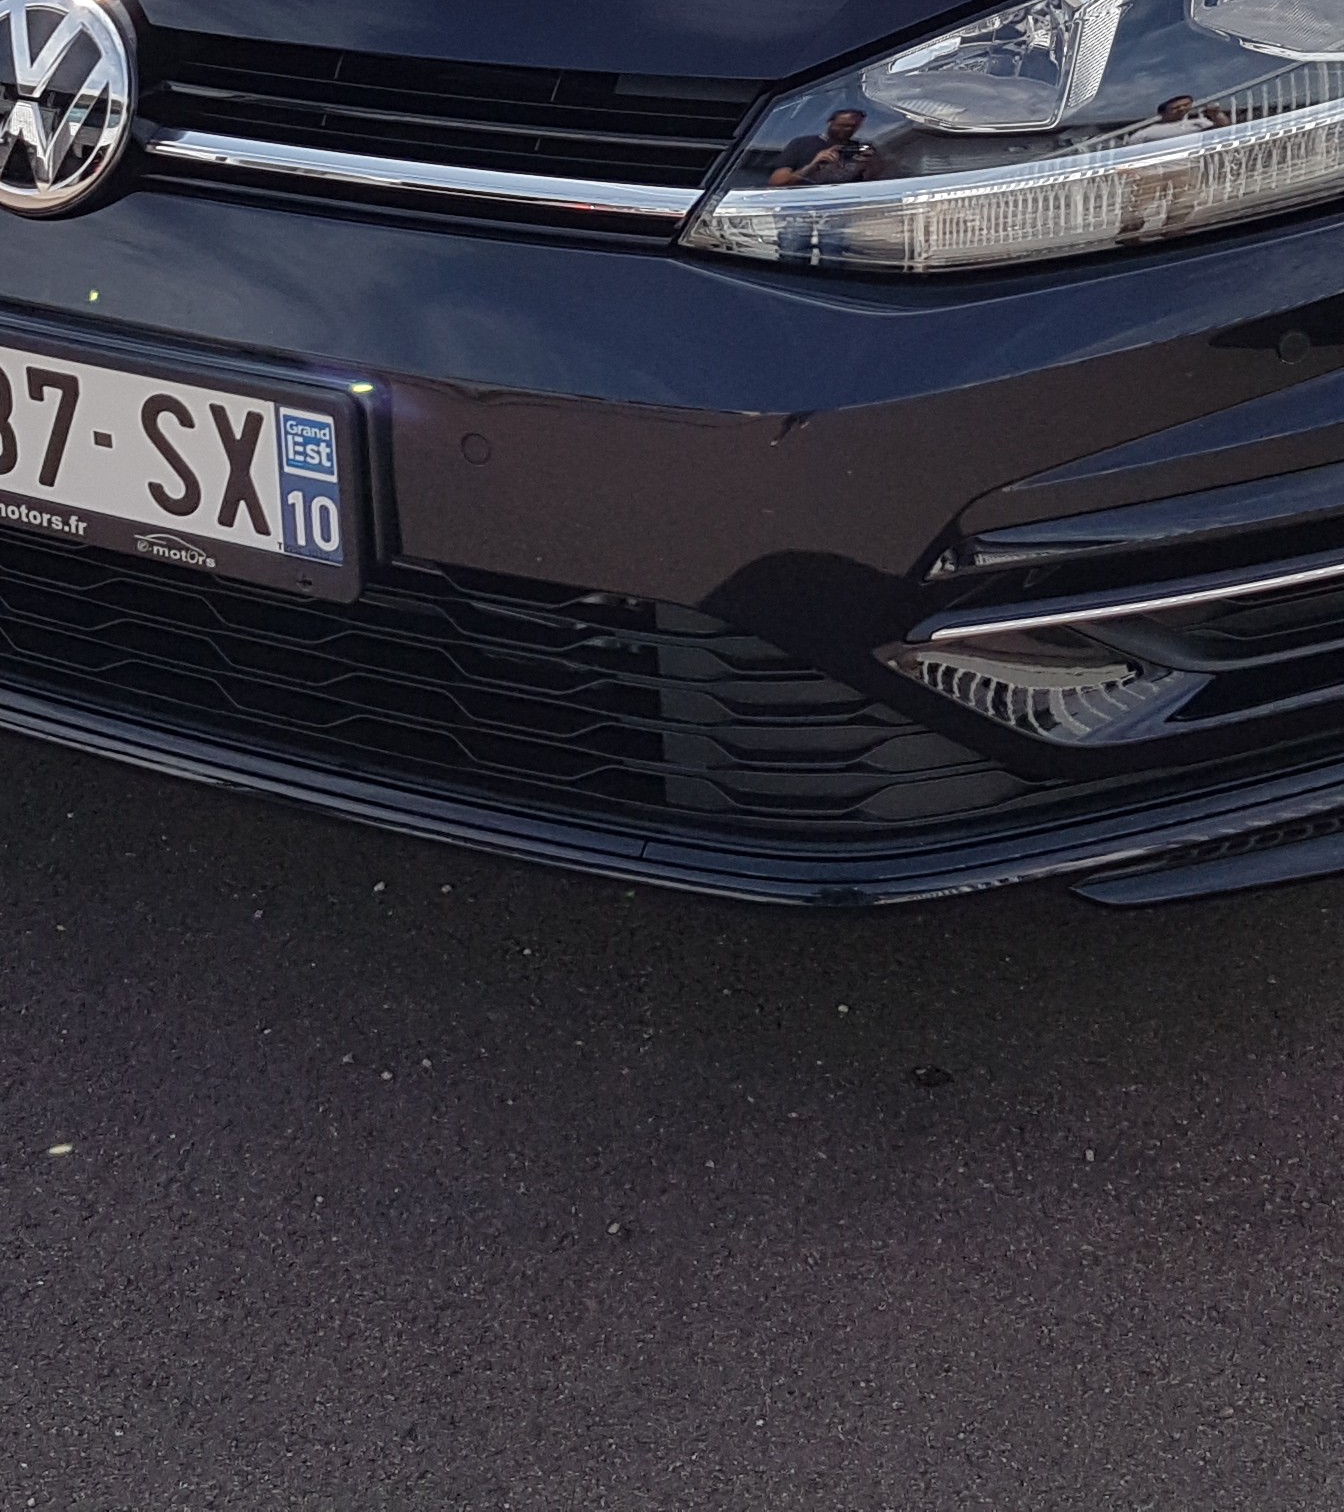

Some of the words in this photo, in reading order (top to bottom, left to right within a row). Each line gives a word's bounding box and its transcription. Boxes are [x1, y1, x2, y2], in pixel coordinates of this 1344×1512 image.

[285, 419, 330, 441] Grand
[287, 434, 332, 468] Est
[287, 490, 340, 553] 10
